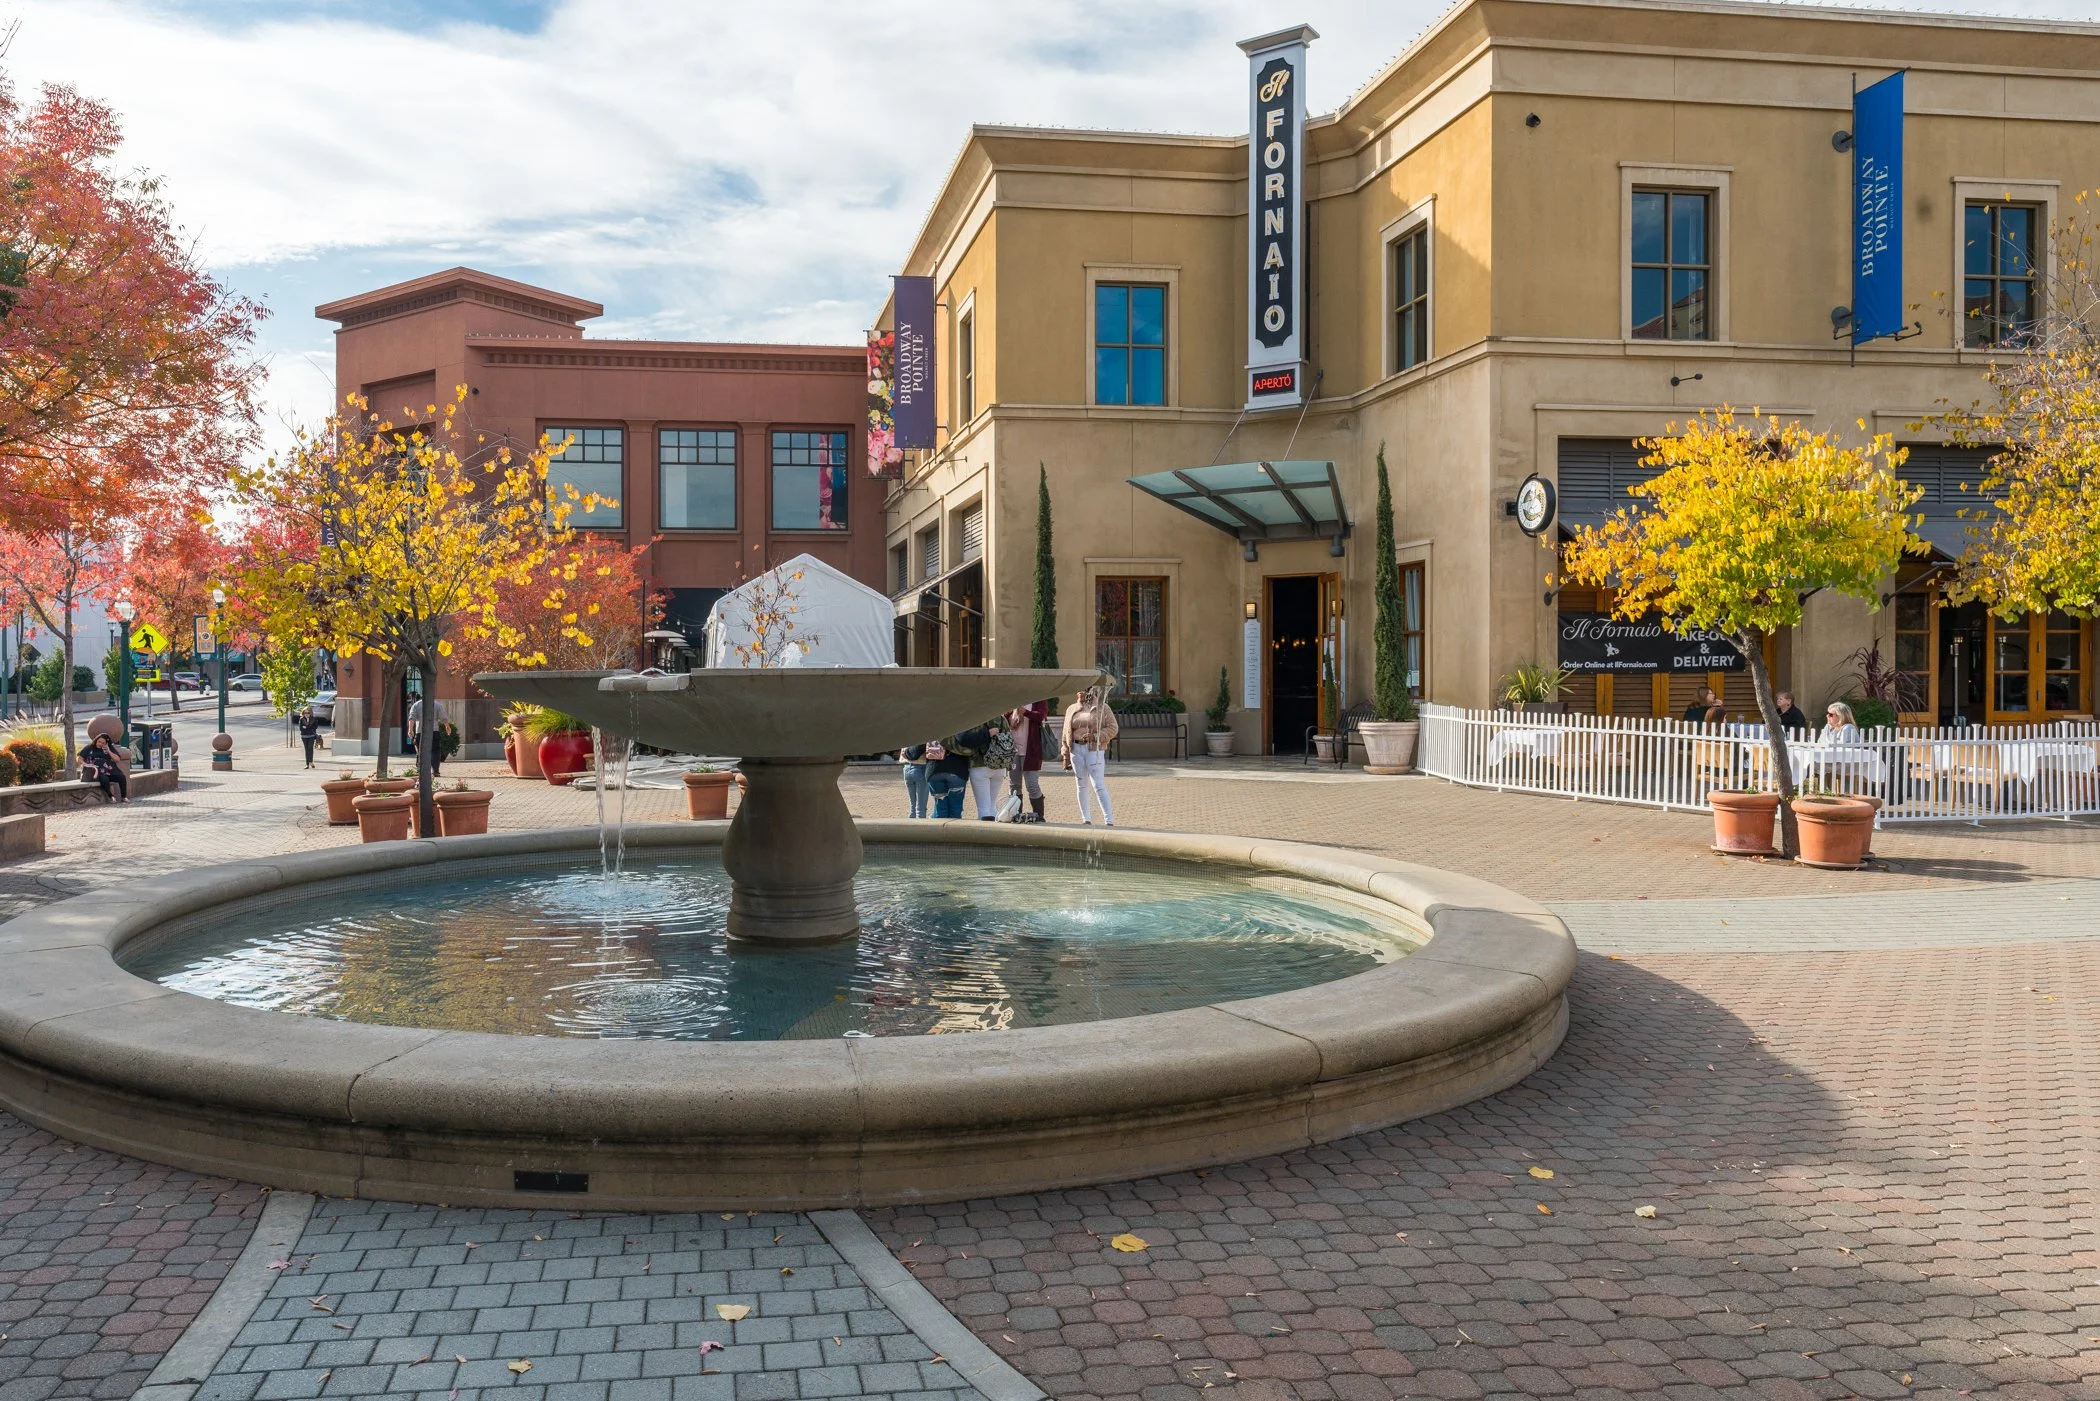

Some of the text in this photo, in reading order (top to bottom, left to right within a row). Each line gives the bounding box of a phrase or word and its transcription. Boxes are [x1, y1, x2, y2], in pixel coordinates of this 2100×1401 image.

[1260, 69, 1290, 332] Il FORNAIO
[1862, 156, 1874, 277] BROADWAY
[1875, 165, 1889, 253] POINTE
[900, 321, 912, 405] BROADWAY
[912, 334, 924, 392] POINTE
[1254, 373, 1292, 390] APERTO
[1562, 618, 1661, 640] Il Fornaio
[1700, 643, 1710, 653] &
[1673, 656, 1736, 667] DELIVERY
